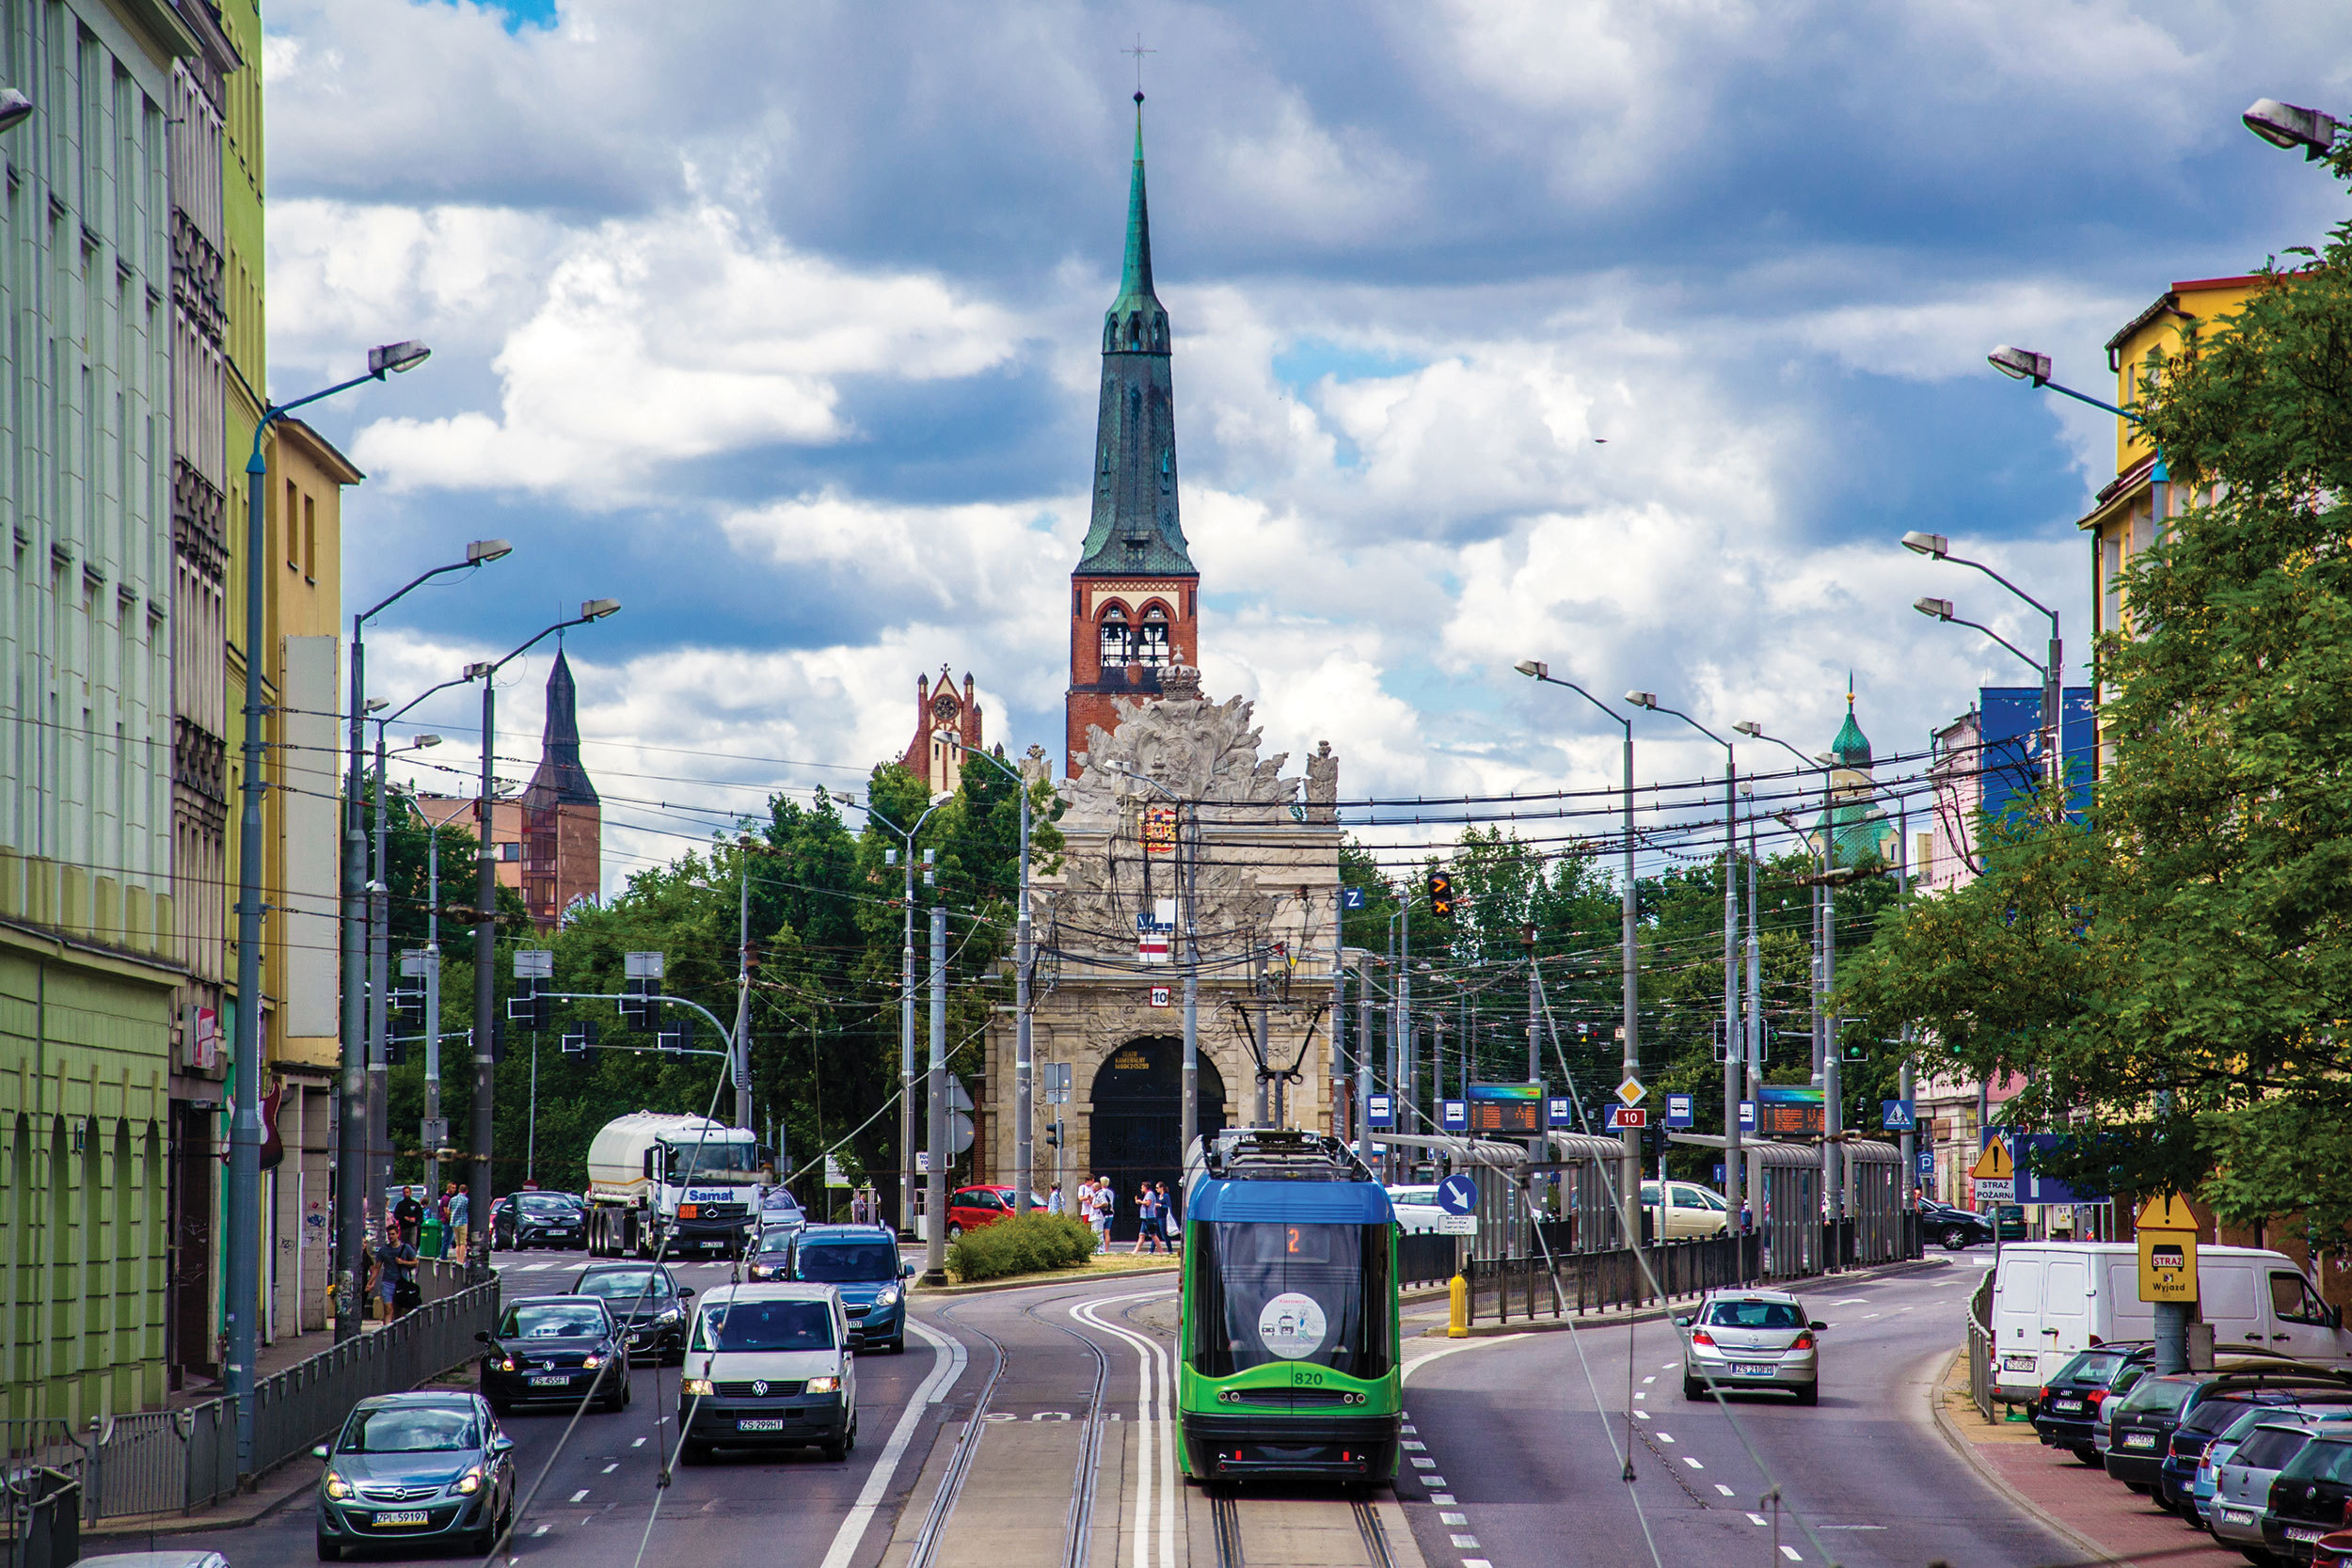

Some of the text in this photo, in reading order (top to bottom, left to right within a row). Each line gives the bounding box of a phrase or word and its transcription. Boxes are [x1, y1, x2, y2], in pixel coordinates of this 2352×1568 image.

[1347, 892, 1360, 907] Z
[1153, 992, 1167, 1003] 10
[1624, 1112, 1638, 1124] 10
[1981, 1180, 2010, 1189] STRAŻ
[689, 1189, 735, 1201] Samat
[1288, 1227, 1299, 1253] 2
[2154, 1256, 2183, 1266] STRAŻ
[2153, 1283, 2185, 1293] Wyjazd
[1294, 1372, 1323, 1386] 820
[741, 1420, 782, 1430] ZS 299HT
[377, 1512, 427, 1524] ZPL 59197
